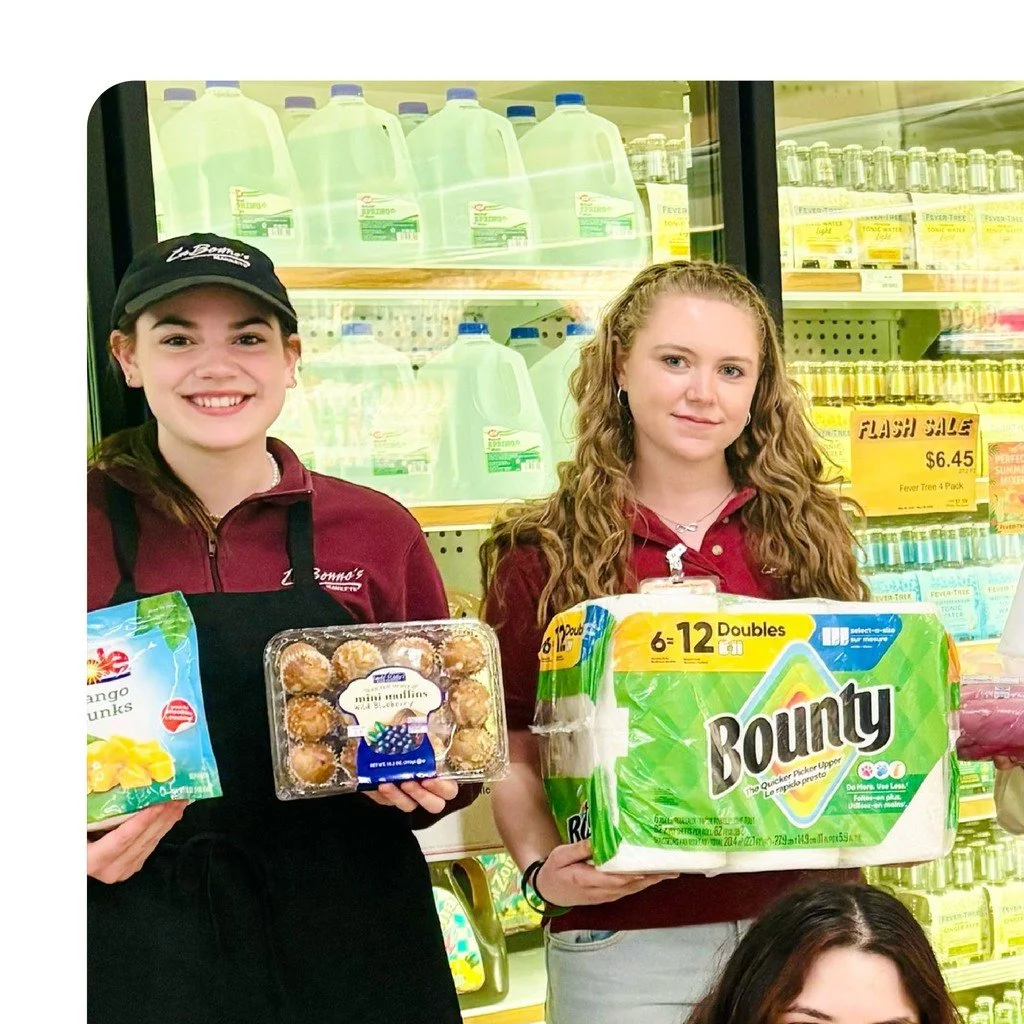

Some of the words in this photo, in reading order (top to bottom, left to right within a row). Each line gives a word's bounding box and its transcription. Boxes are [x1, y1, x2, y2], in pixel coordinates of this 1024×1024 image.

[858, 417, 917, 440] FLASH
[925, 416, 974, 437] SALE
[926, 450, 974, 469] $6.45
[899, 484, 921, 493] Fever
[921, 483, 937, 491] Tree
[945, 482, 964, 491] Pack
[930, 588, 971, 598] FEVER-TREE
[940, 604, 963, 612] TONIC
[677, 621, 714, 653] 12
[717, 621, 786, 637] Doubles
[87, 686, 130, 704] ango
[355, 692, 381, 703] mini
[386, 689, 428, 701] muffins
[88, 701, 133, 722] unks
[711, 682, 892, 796] Bounty
[746, 785, 760, 797] The
[761, 774, 792, 791] Quicker
[793, 766, 818, 782] Picker
[818, 757, 843, 773] Upper
[802, 772, 828, 787] presto
[876, 782, 889, 790] Use
